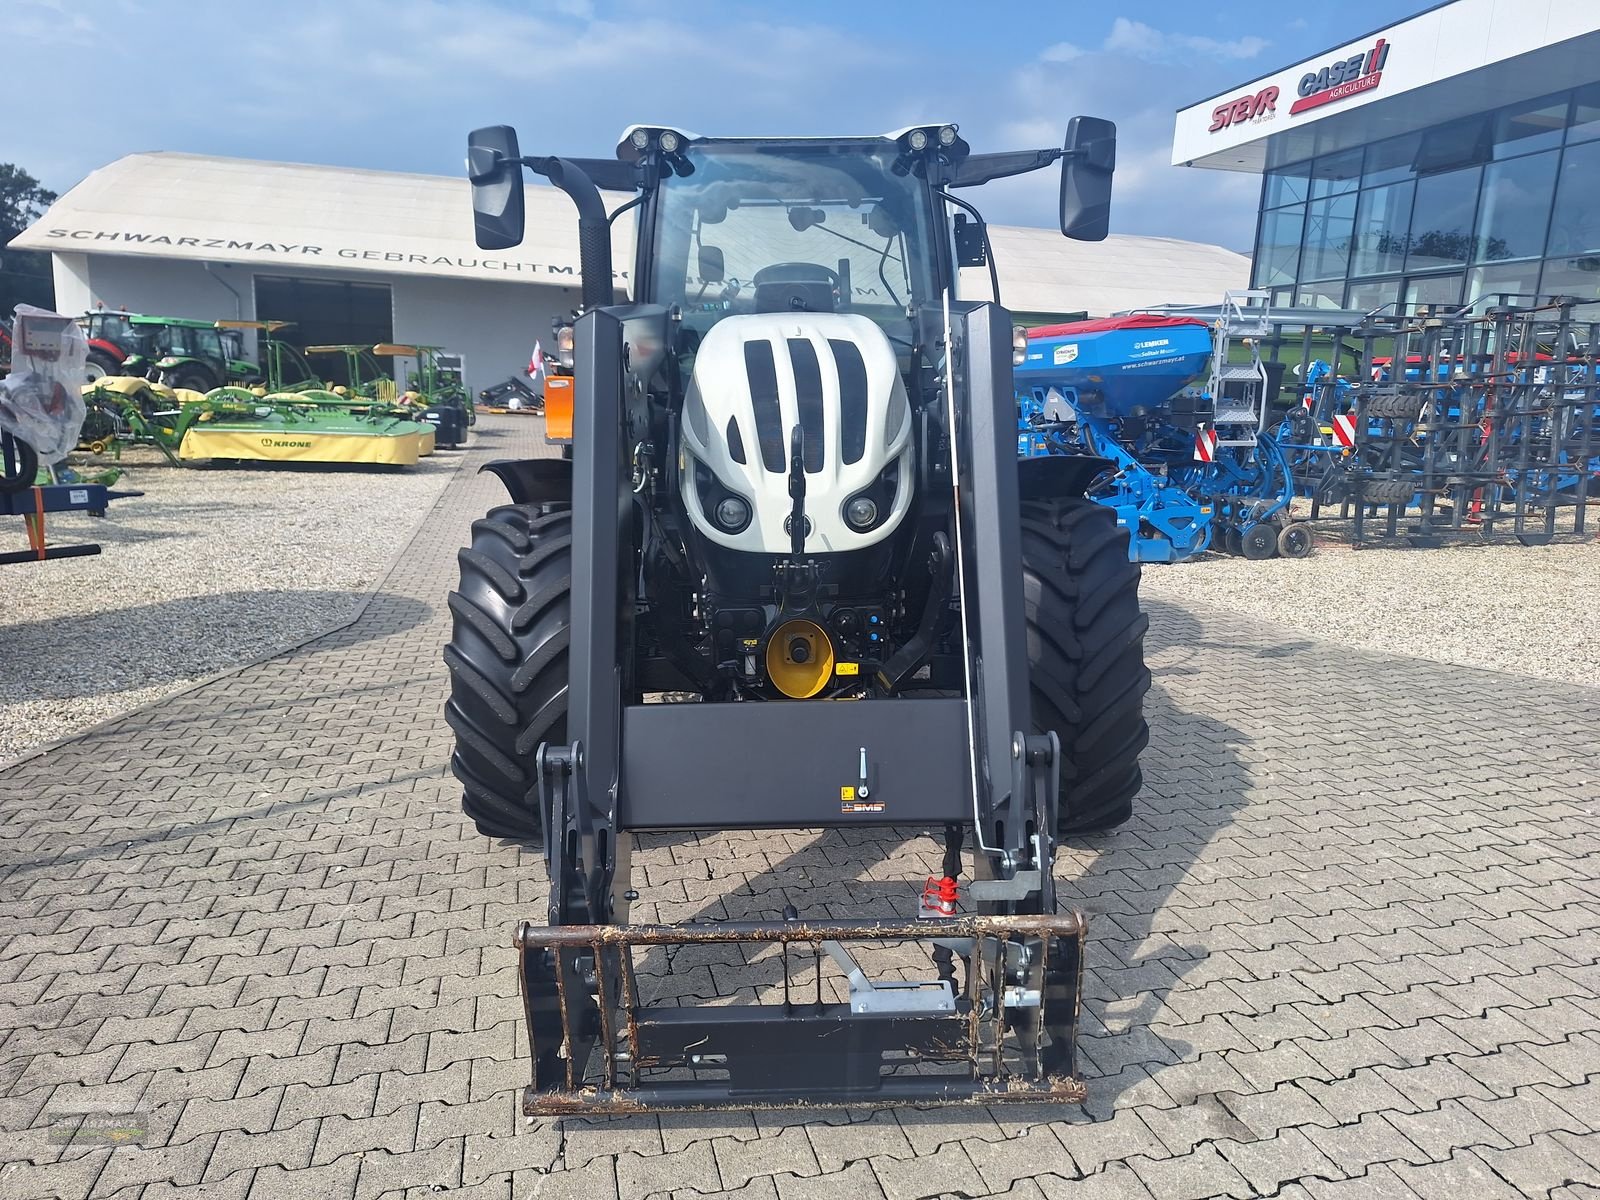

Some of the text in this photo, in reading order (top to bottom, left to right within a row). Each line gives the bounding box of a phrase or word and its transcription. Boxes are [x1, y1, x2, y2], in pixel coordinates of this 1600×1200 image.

[1297, 53, 1365, 97] CASE
[1329, 76, 1376, 99] AGRICULTURE
[1208, 85, 1280, 133] STEYR
[47, 228, 323, 255] SCHWARZMAYR
[1141, 339, 1169, 348] LEMKEN
[1122, 356, 1185, 370] www.schwarzmayr.at
